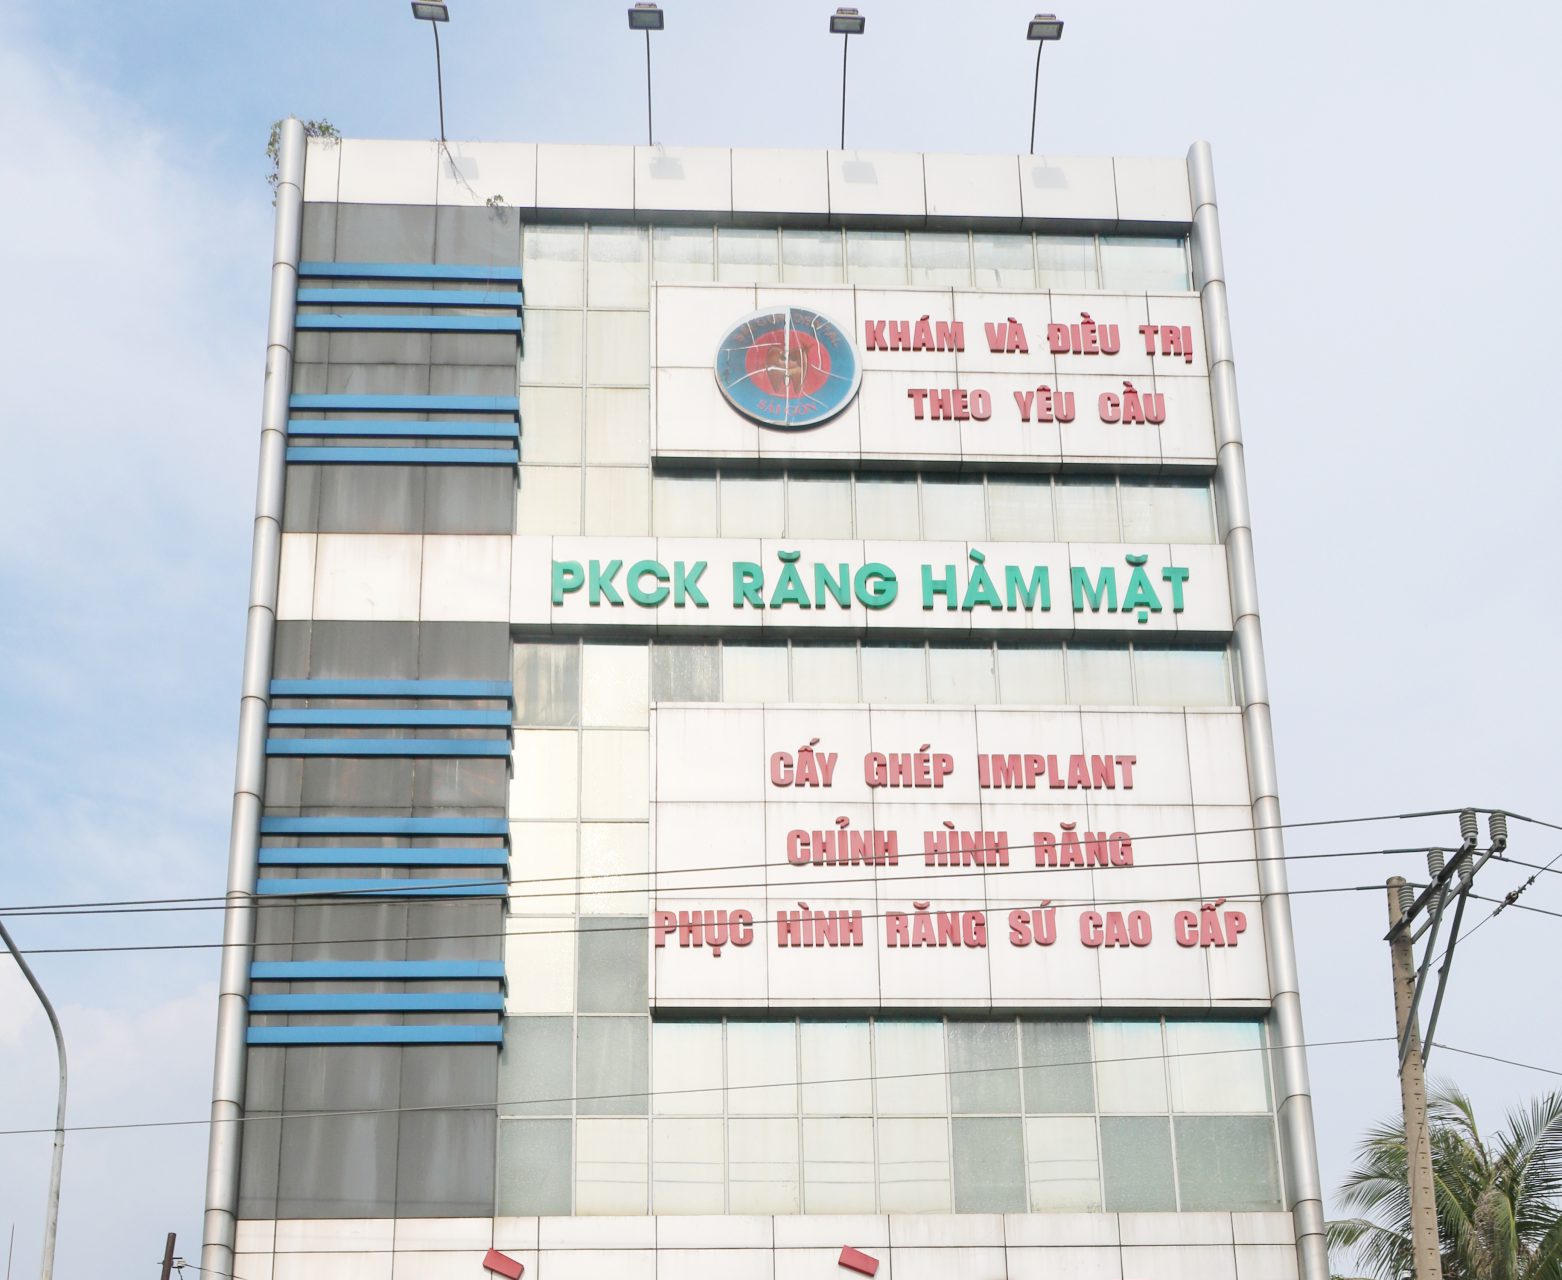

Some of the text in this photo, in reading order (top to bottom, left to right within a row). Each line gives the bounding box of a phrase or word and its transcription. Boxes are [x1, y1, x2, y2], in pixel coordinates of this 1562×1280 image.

[864, 311, 1194, 364] KHÁM VÀ ĐIỀU TRỊ
[908, 380, 1167, 425] THEO YÊU CẦU
[551, 549, 1190, 624] PKCK RĂNG HÀM MẶT
[770, 738, 1137, 791] CẤY GHÉP IMPLANT
[786, 815, 1134, 868] CHỈNH HÌNH RĂNG
[655, 897, 1248, 958] PHỤC HÌNH RĂNG SỨ CAO CẤP
